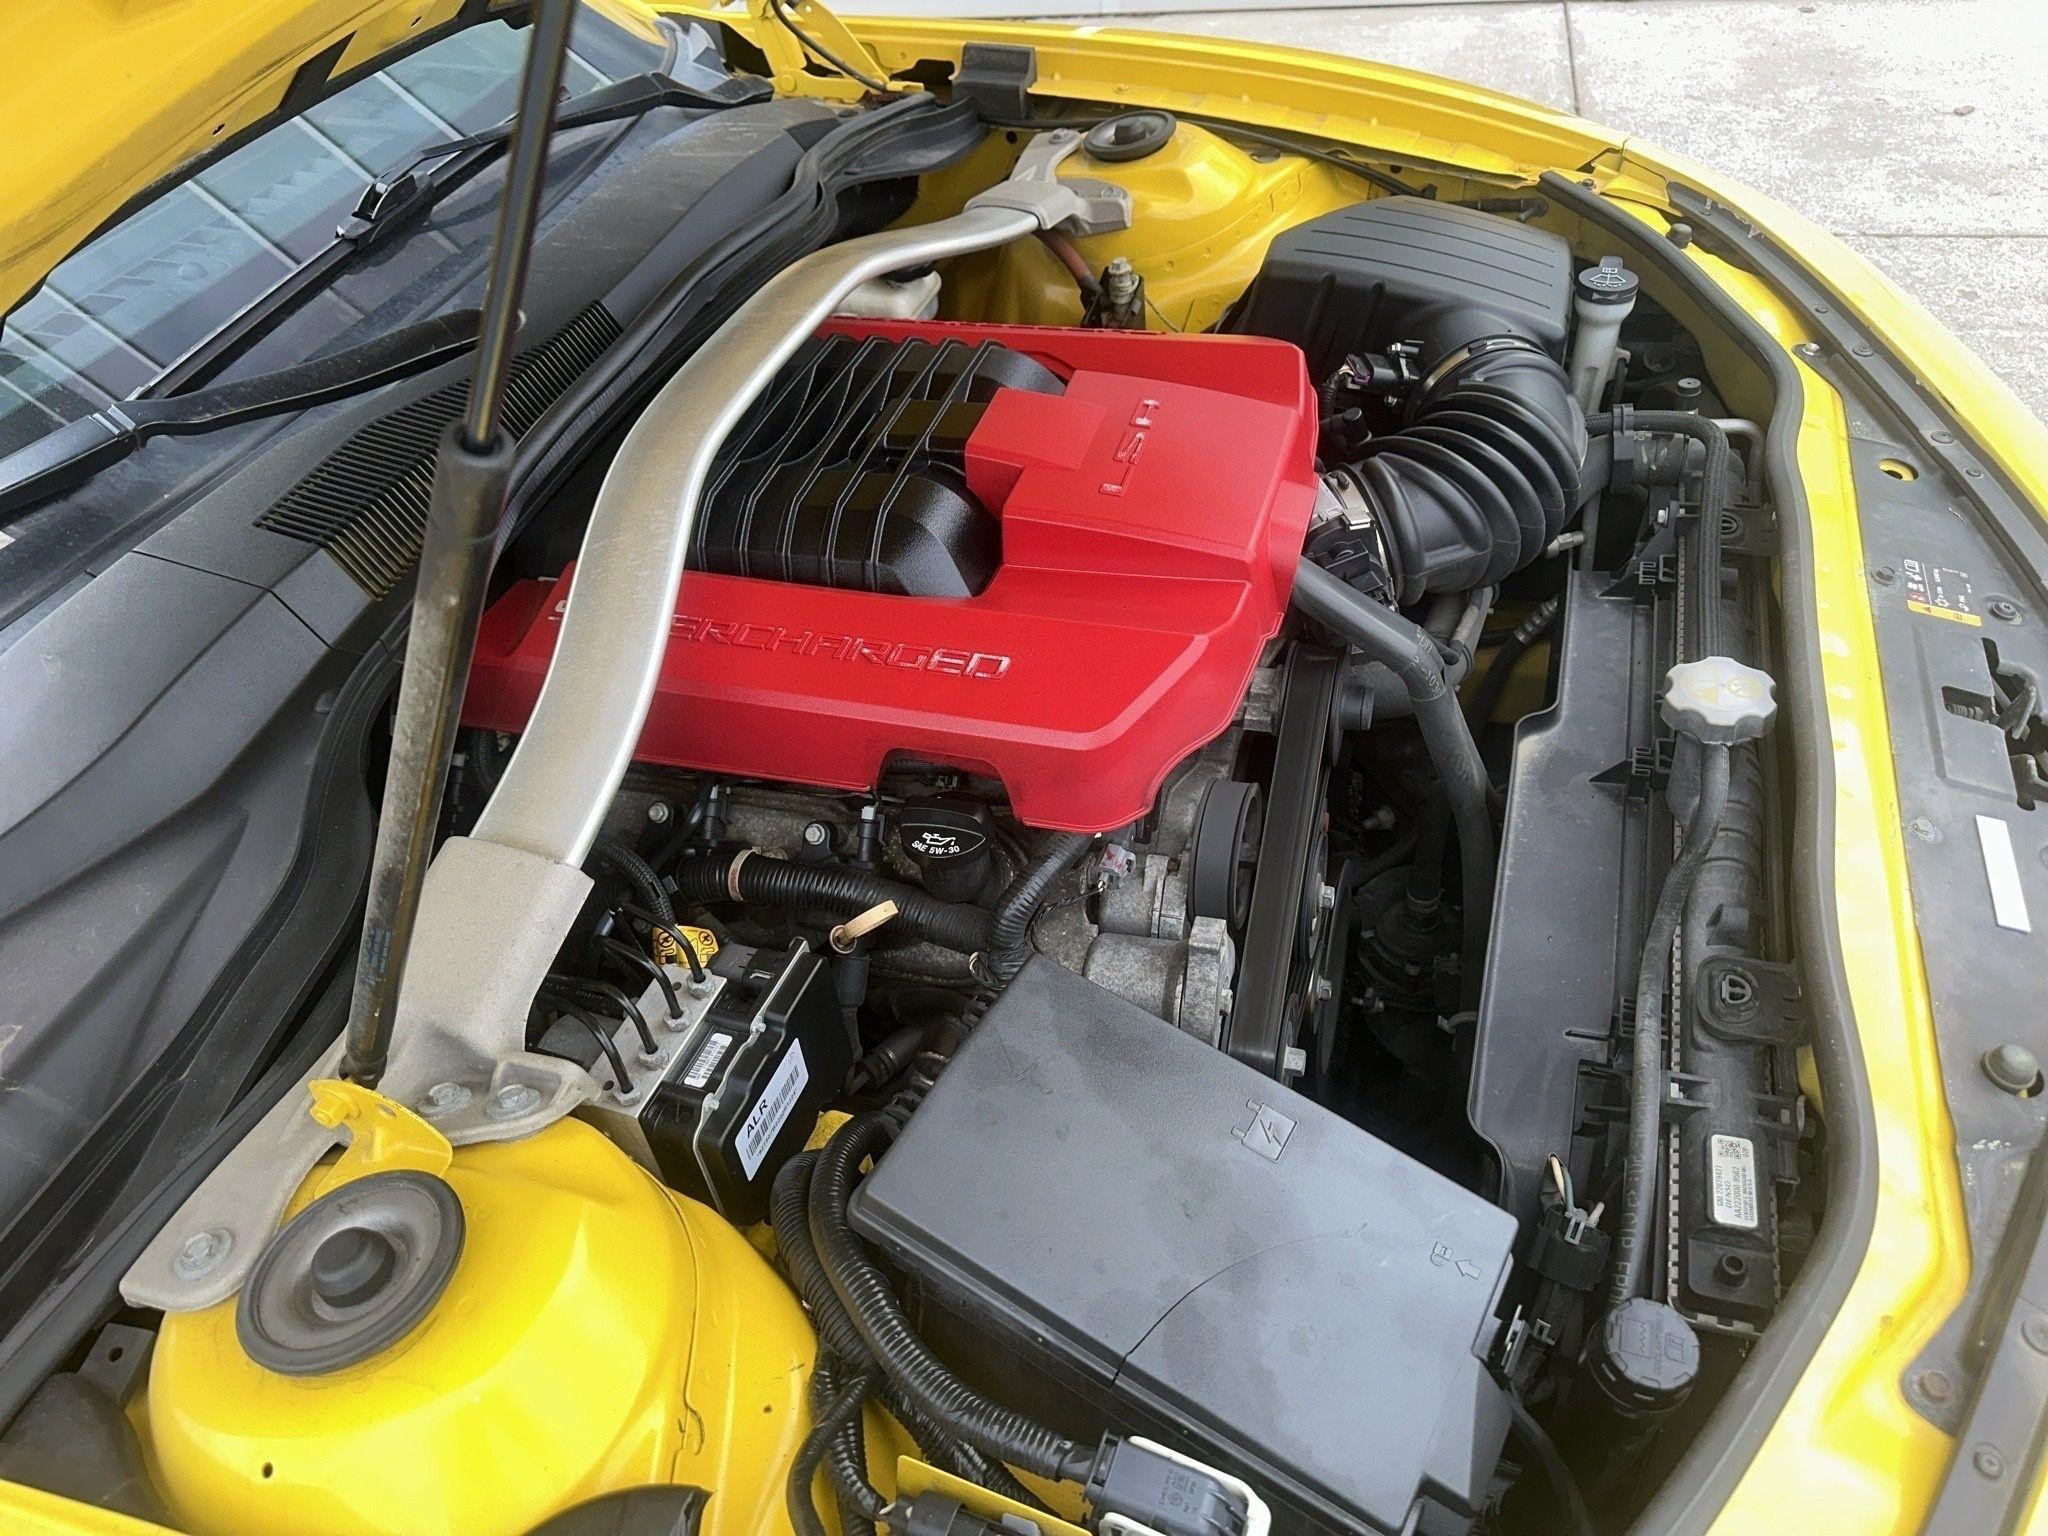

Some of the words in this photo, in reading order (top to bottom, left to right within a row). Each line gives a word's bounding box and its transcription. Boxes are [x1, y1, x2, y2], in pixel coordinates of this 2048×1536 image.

[548, 598, 1011, 680] ERCHARGED
[911, 840, 929, 852] SAE
[929, 845, 960, 855] 5W-30
[746, 1099, 768, 1138] ALR
[1724, 1180, 1732, 1209] DENSO
